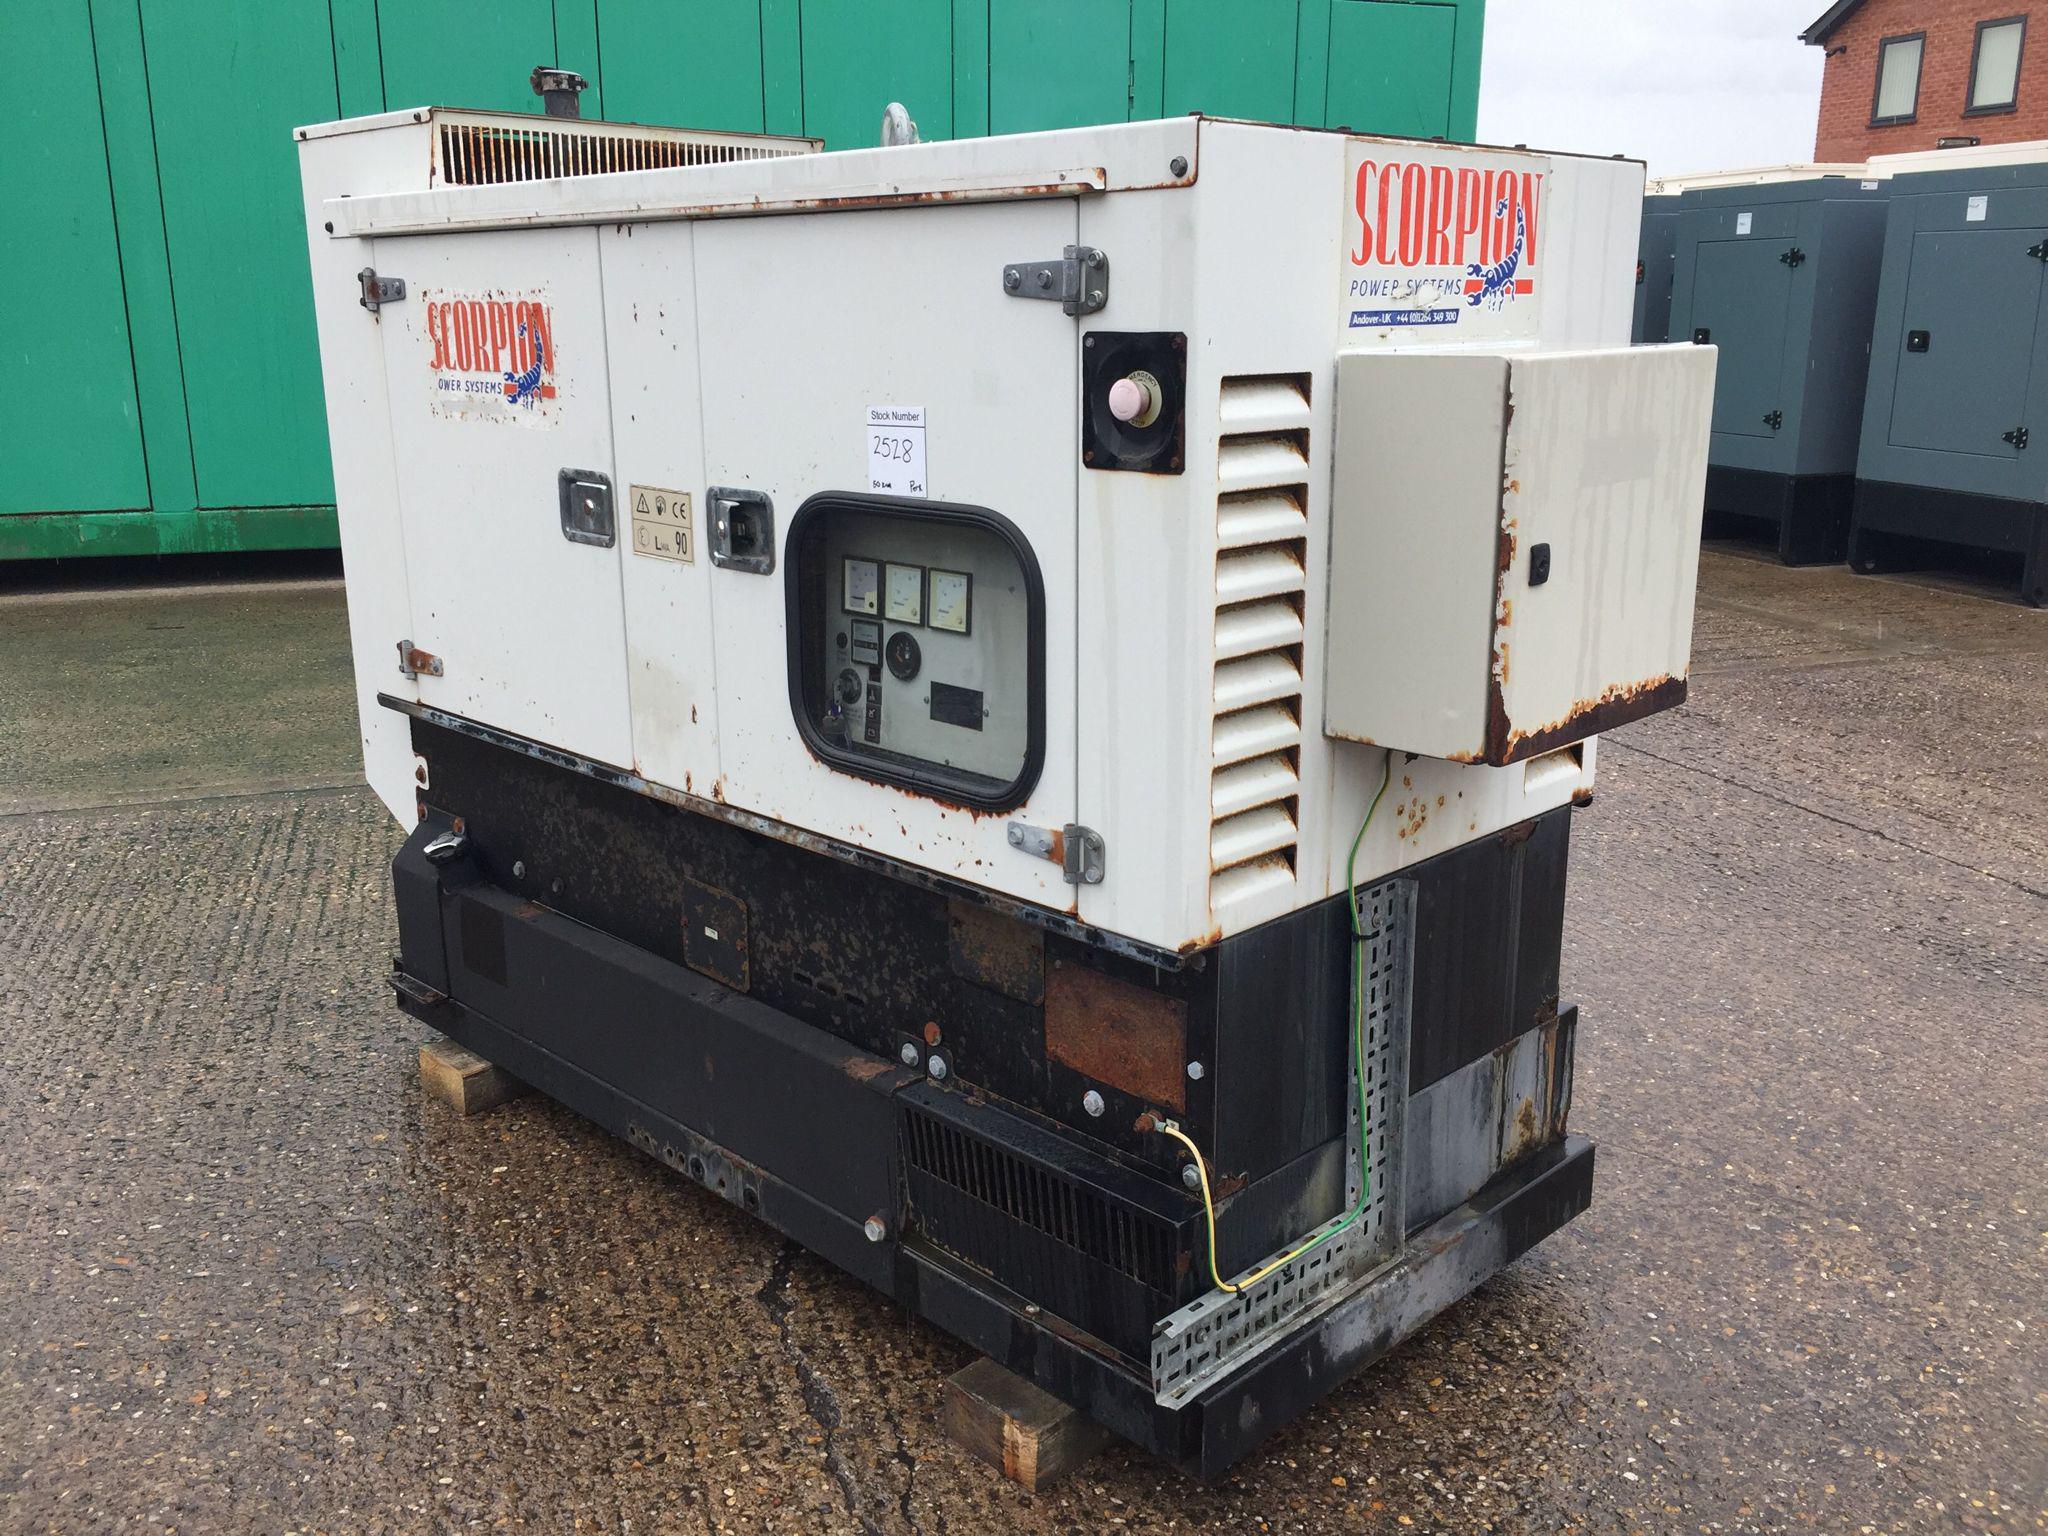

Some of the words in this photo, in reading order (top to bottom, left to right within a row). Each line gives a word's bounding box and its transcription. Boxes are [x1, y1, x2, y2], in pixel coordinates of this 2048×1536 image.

[1351, 160, 1544, 267] SCORPION
[1445, 311, 1457, 321] 300
[427, 300, 555, 375] SCORPION
[465, 380, 503, 395] SYSTEMS
[871, 410, 890, 420] Stock
[892, 411, 920, 421] Number
[873, 435, 913, 463] 2528
[675, 531, 688, 555] 90
